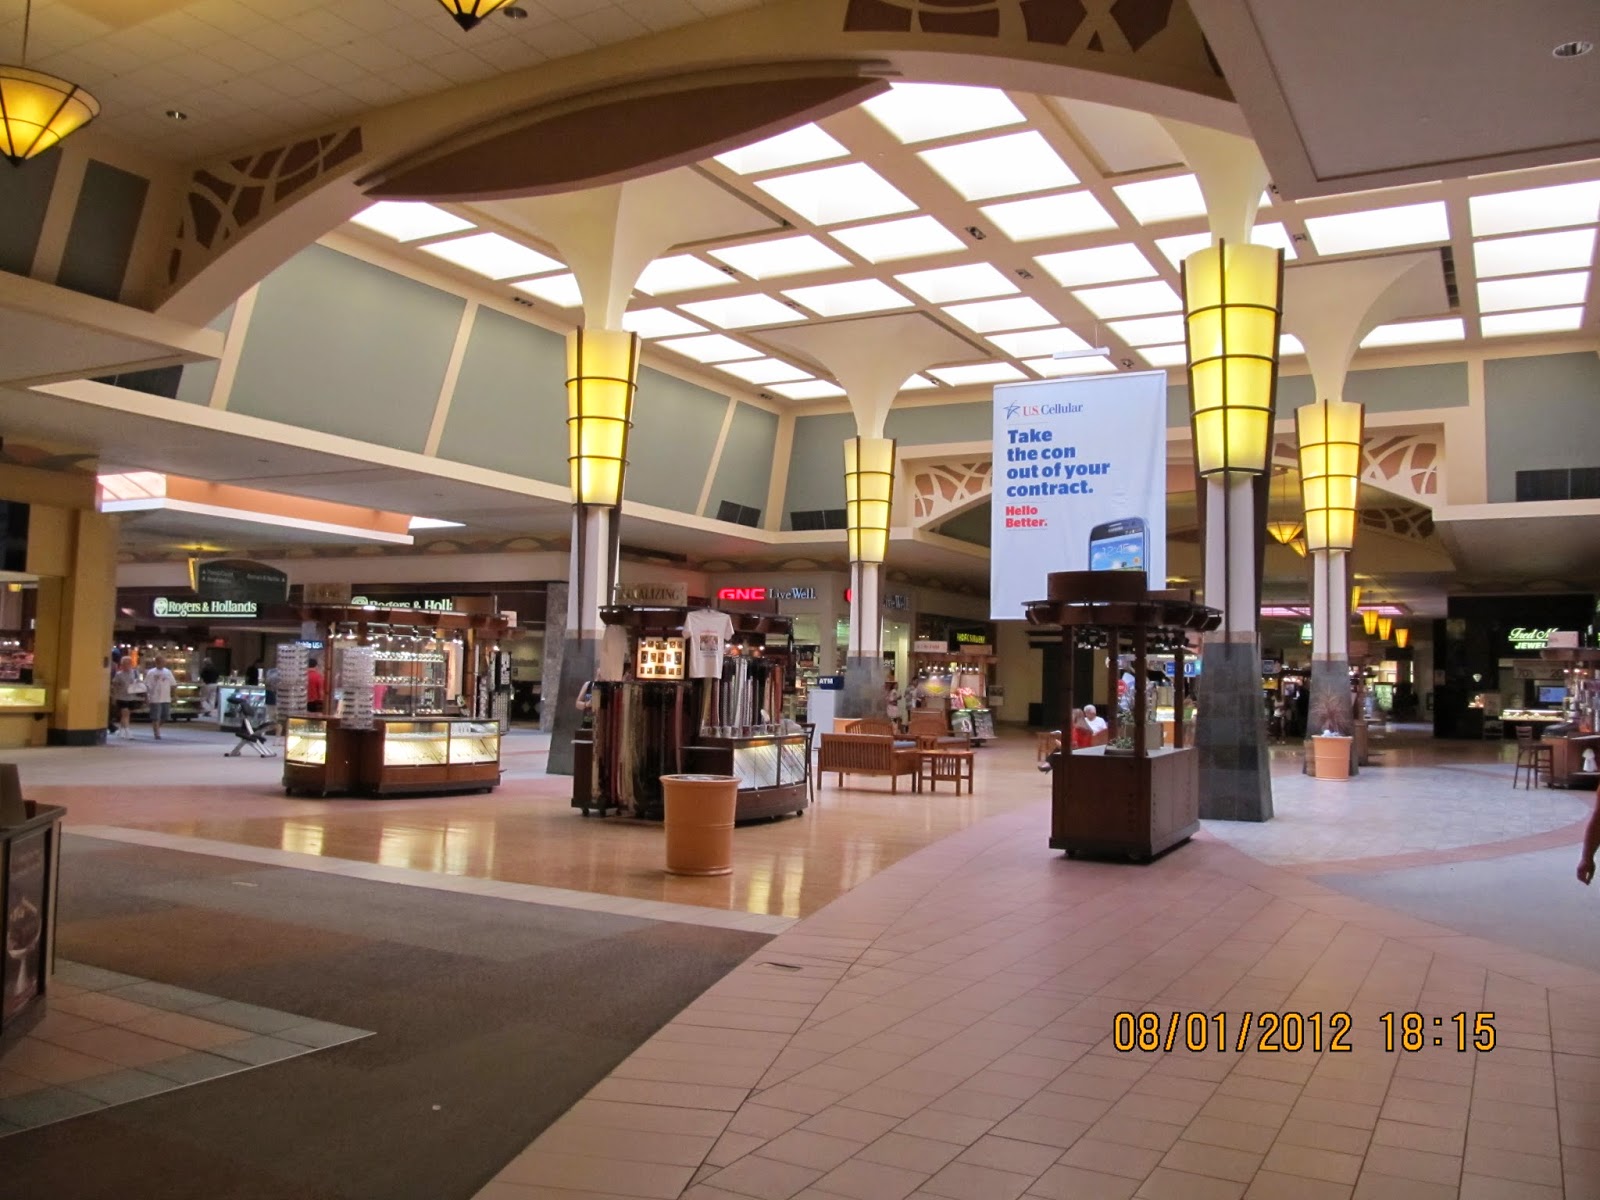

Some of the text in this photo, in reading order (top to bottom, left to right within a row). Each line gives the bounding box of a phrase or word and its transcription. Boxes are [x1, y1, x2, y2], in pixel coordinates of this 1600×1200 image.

[1041, 402, 1084, 415] Cellular
[1007, 428, 1053, 444] Take
[1007, 446, 1076, 462] the con
[1006, 462, 1110, 480] out of your
[1006, 480, 1094, 497] contract.
[1005, 505, 1038, 517] Hello
[1005, 518, 1048, 529] Better.
[718, 588, 766, 601] GNC
[168, 600, 258, 617] Rogers & Hollands
[1508, 627, 1539, 640] Fred
[312, 641, 324, 649] USA
[1514, 641, 1547, 650] JEWEL
[818, 677, 834, 685] ATM
